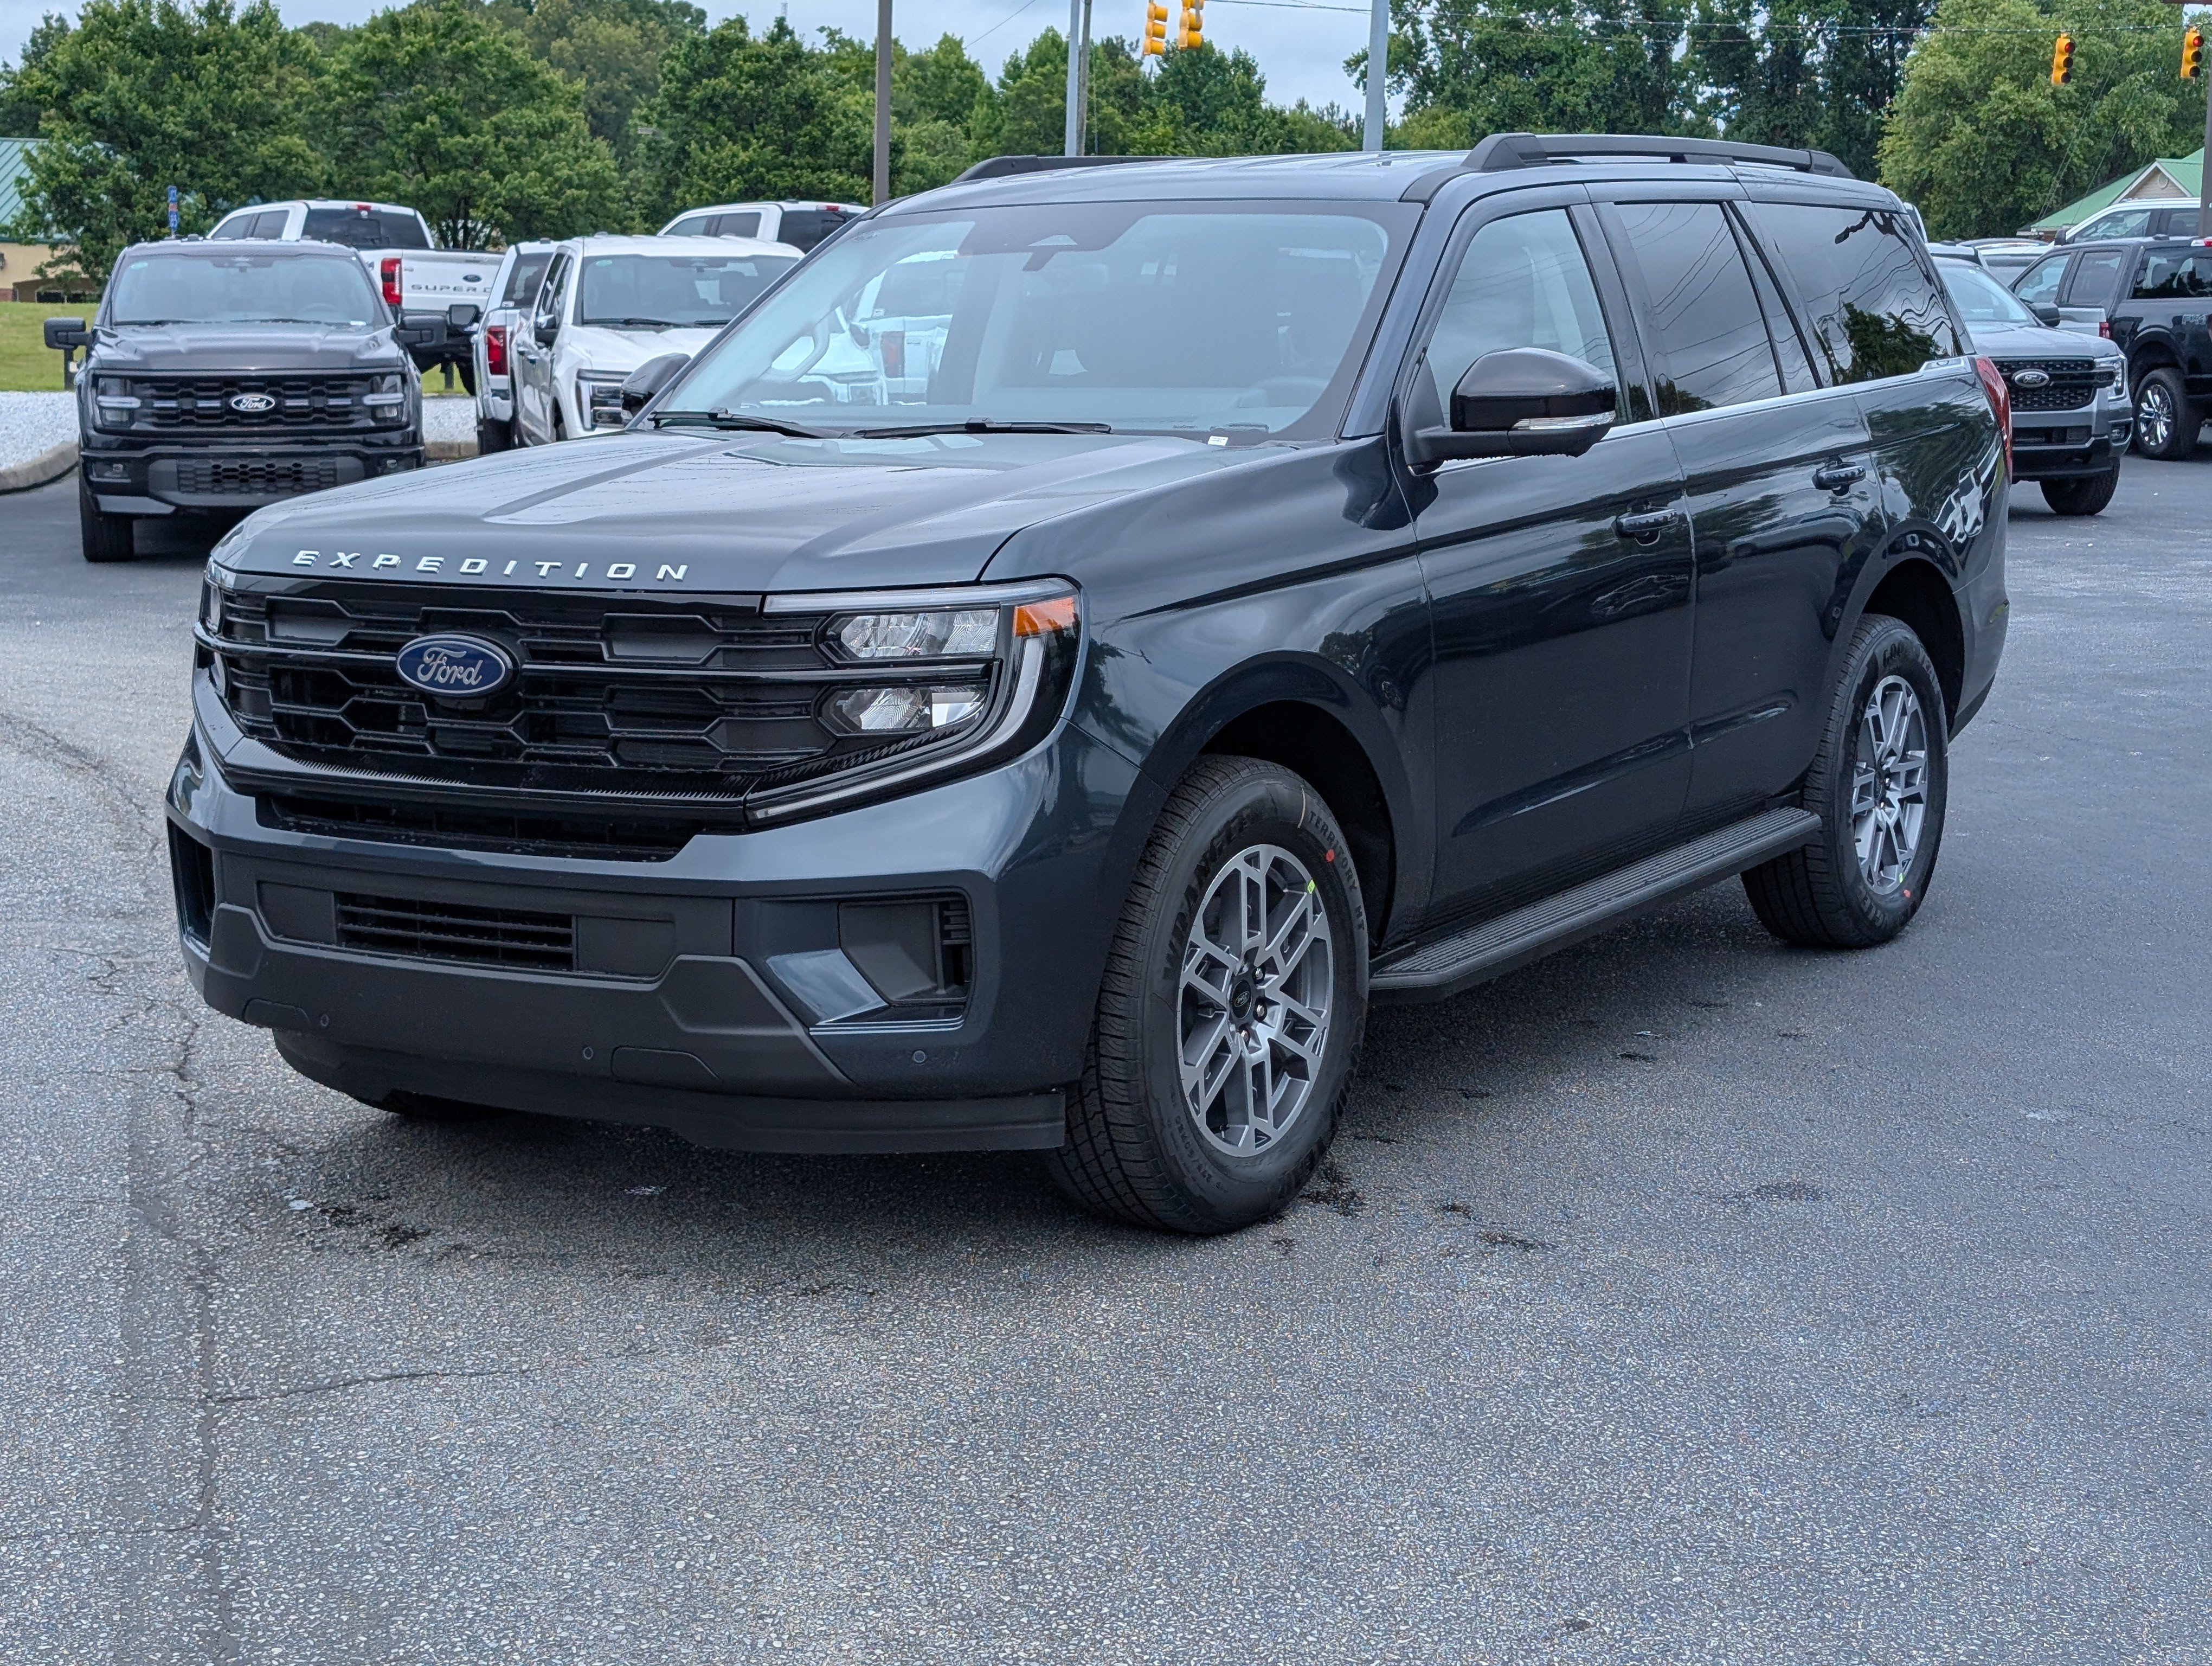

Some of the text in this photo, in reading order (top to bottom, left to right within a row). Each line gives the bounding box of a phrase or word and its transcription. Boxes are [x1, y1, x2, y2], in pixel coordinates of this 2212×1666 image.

[411, 284, 478, 293] SUPER
[240, 398, 267, 409] Ford
[292, 549, 689, 581] EXPEDITION
[417, 647, 484, 685] Ford
[1308, 810, 1358, 892] TERRITORY
